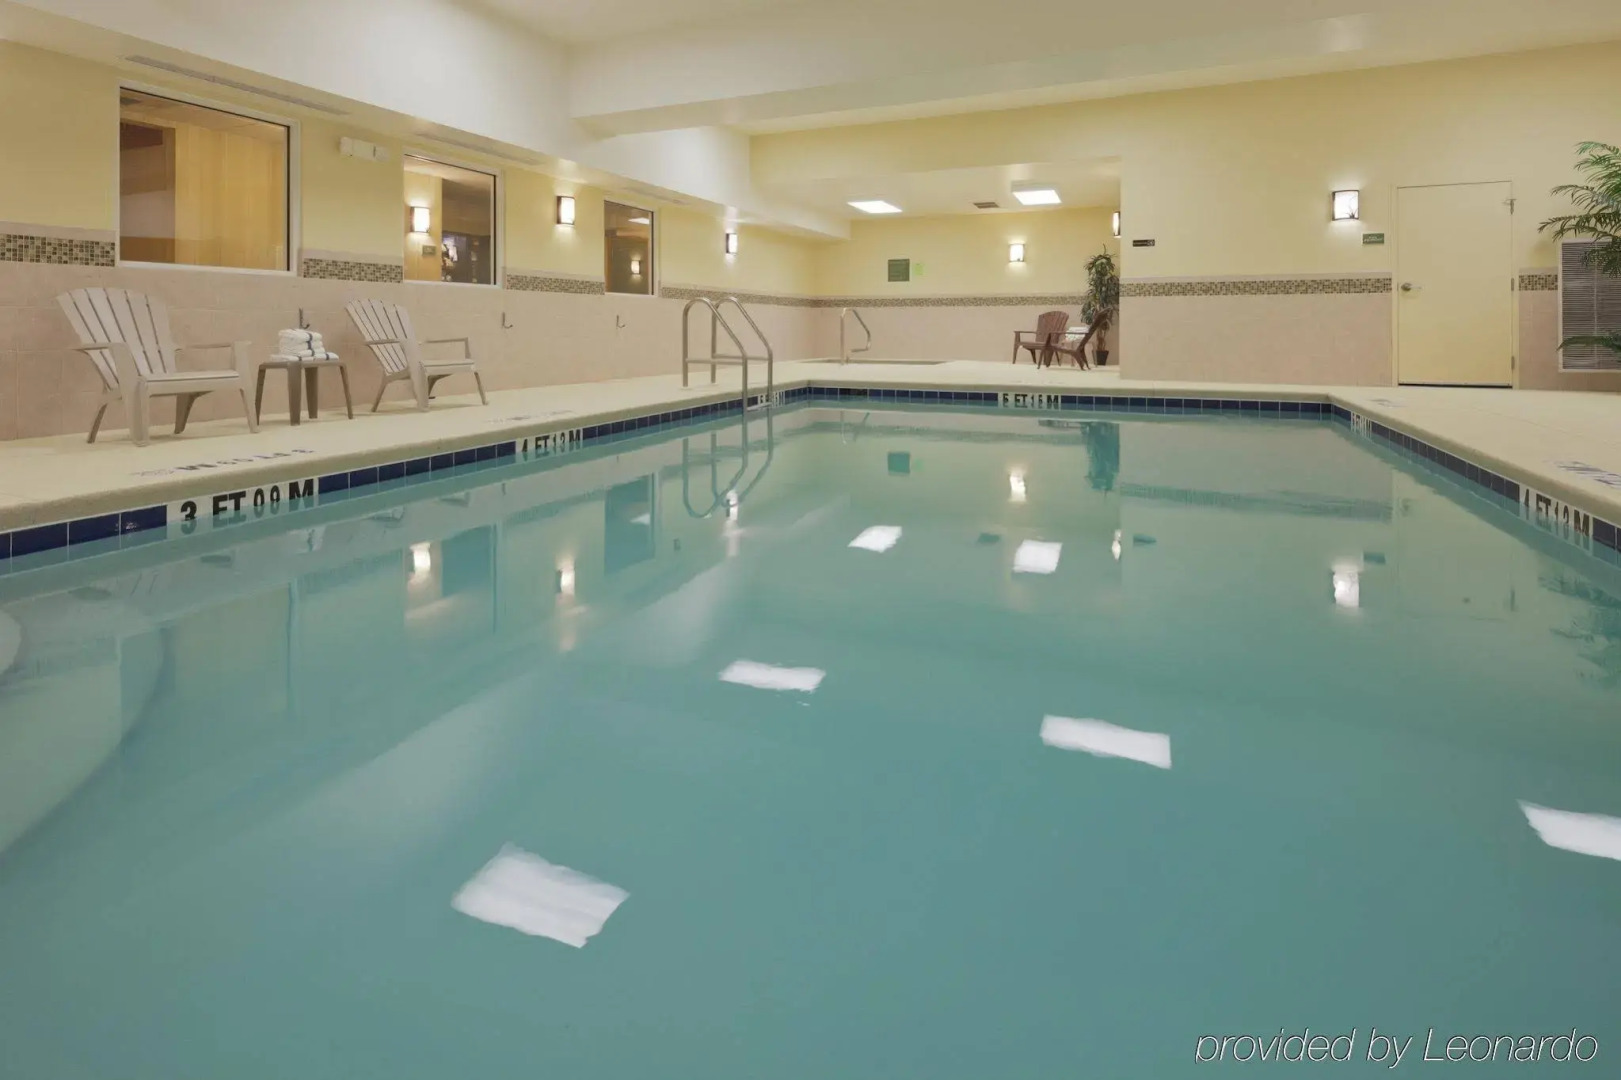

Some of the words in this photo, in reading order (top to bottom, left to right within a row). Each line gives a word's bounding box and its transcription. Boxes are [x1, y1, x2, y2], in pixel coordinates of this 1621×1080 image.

[1014, 393, 1028, 404] FT
[1047, 395, 1059, 405] M
[535, 434, 550, 450] FT
[569, 428, 581, 443] M
[180, 500, 197, 521] 3
[212, 490, 246, 516] FT
[288, 478, 314, 501] M
[1536, 492, 1552, 518] FT
[1573, 509, 1590, 537] M
